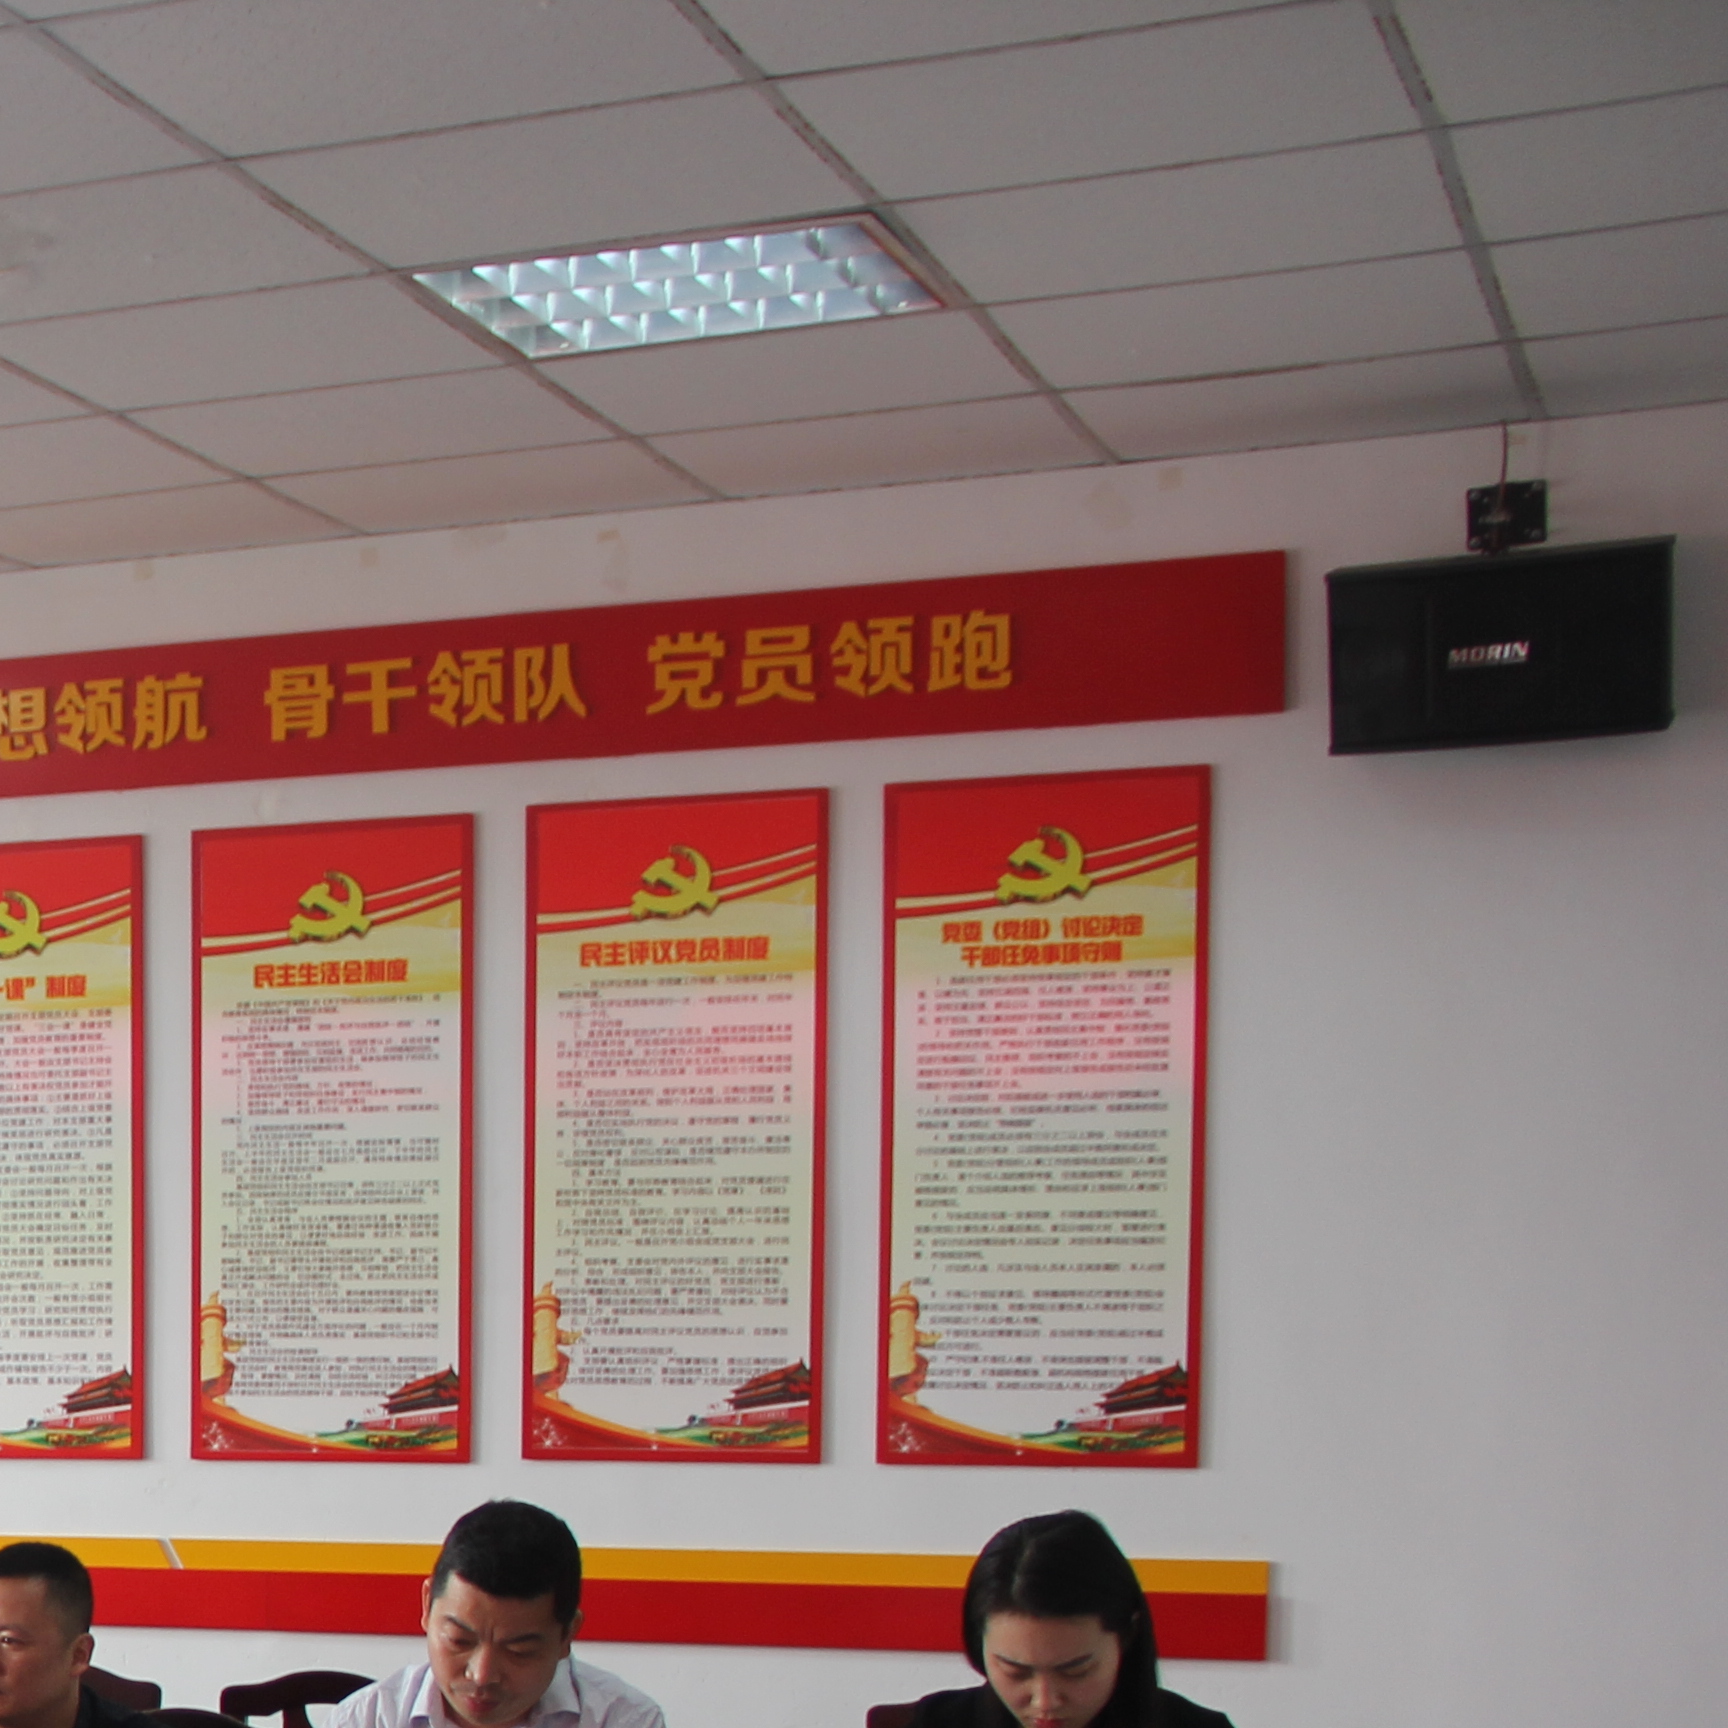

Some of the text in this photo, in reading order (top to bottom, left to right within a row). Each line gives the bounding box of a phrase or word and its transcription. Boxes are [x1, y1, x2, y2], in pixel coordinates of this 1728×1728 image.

[263, 643, 587, 741] 骨干领队
[647, 610, 1013, 710] 党员领跑
[579, 935, 770, 968] 民主评议党员制度
[960, 940, 1124, 969] 干部任免事项守则
[253, 958, 409, 989] 民主生活会制度
